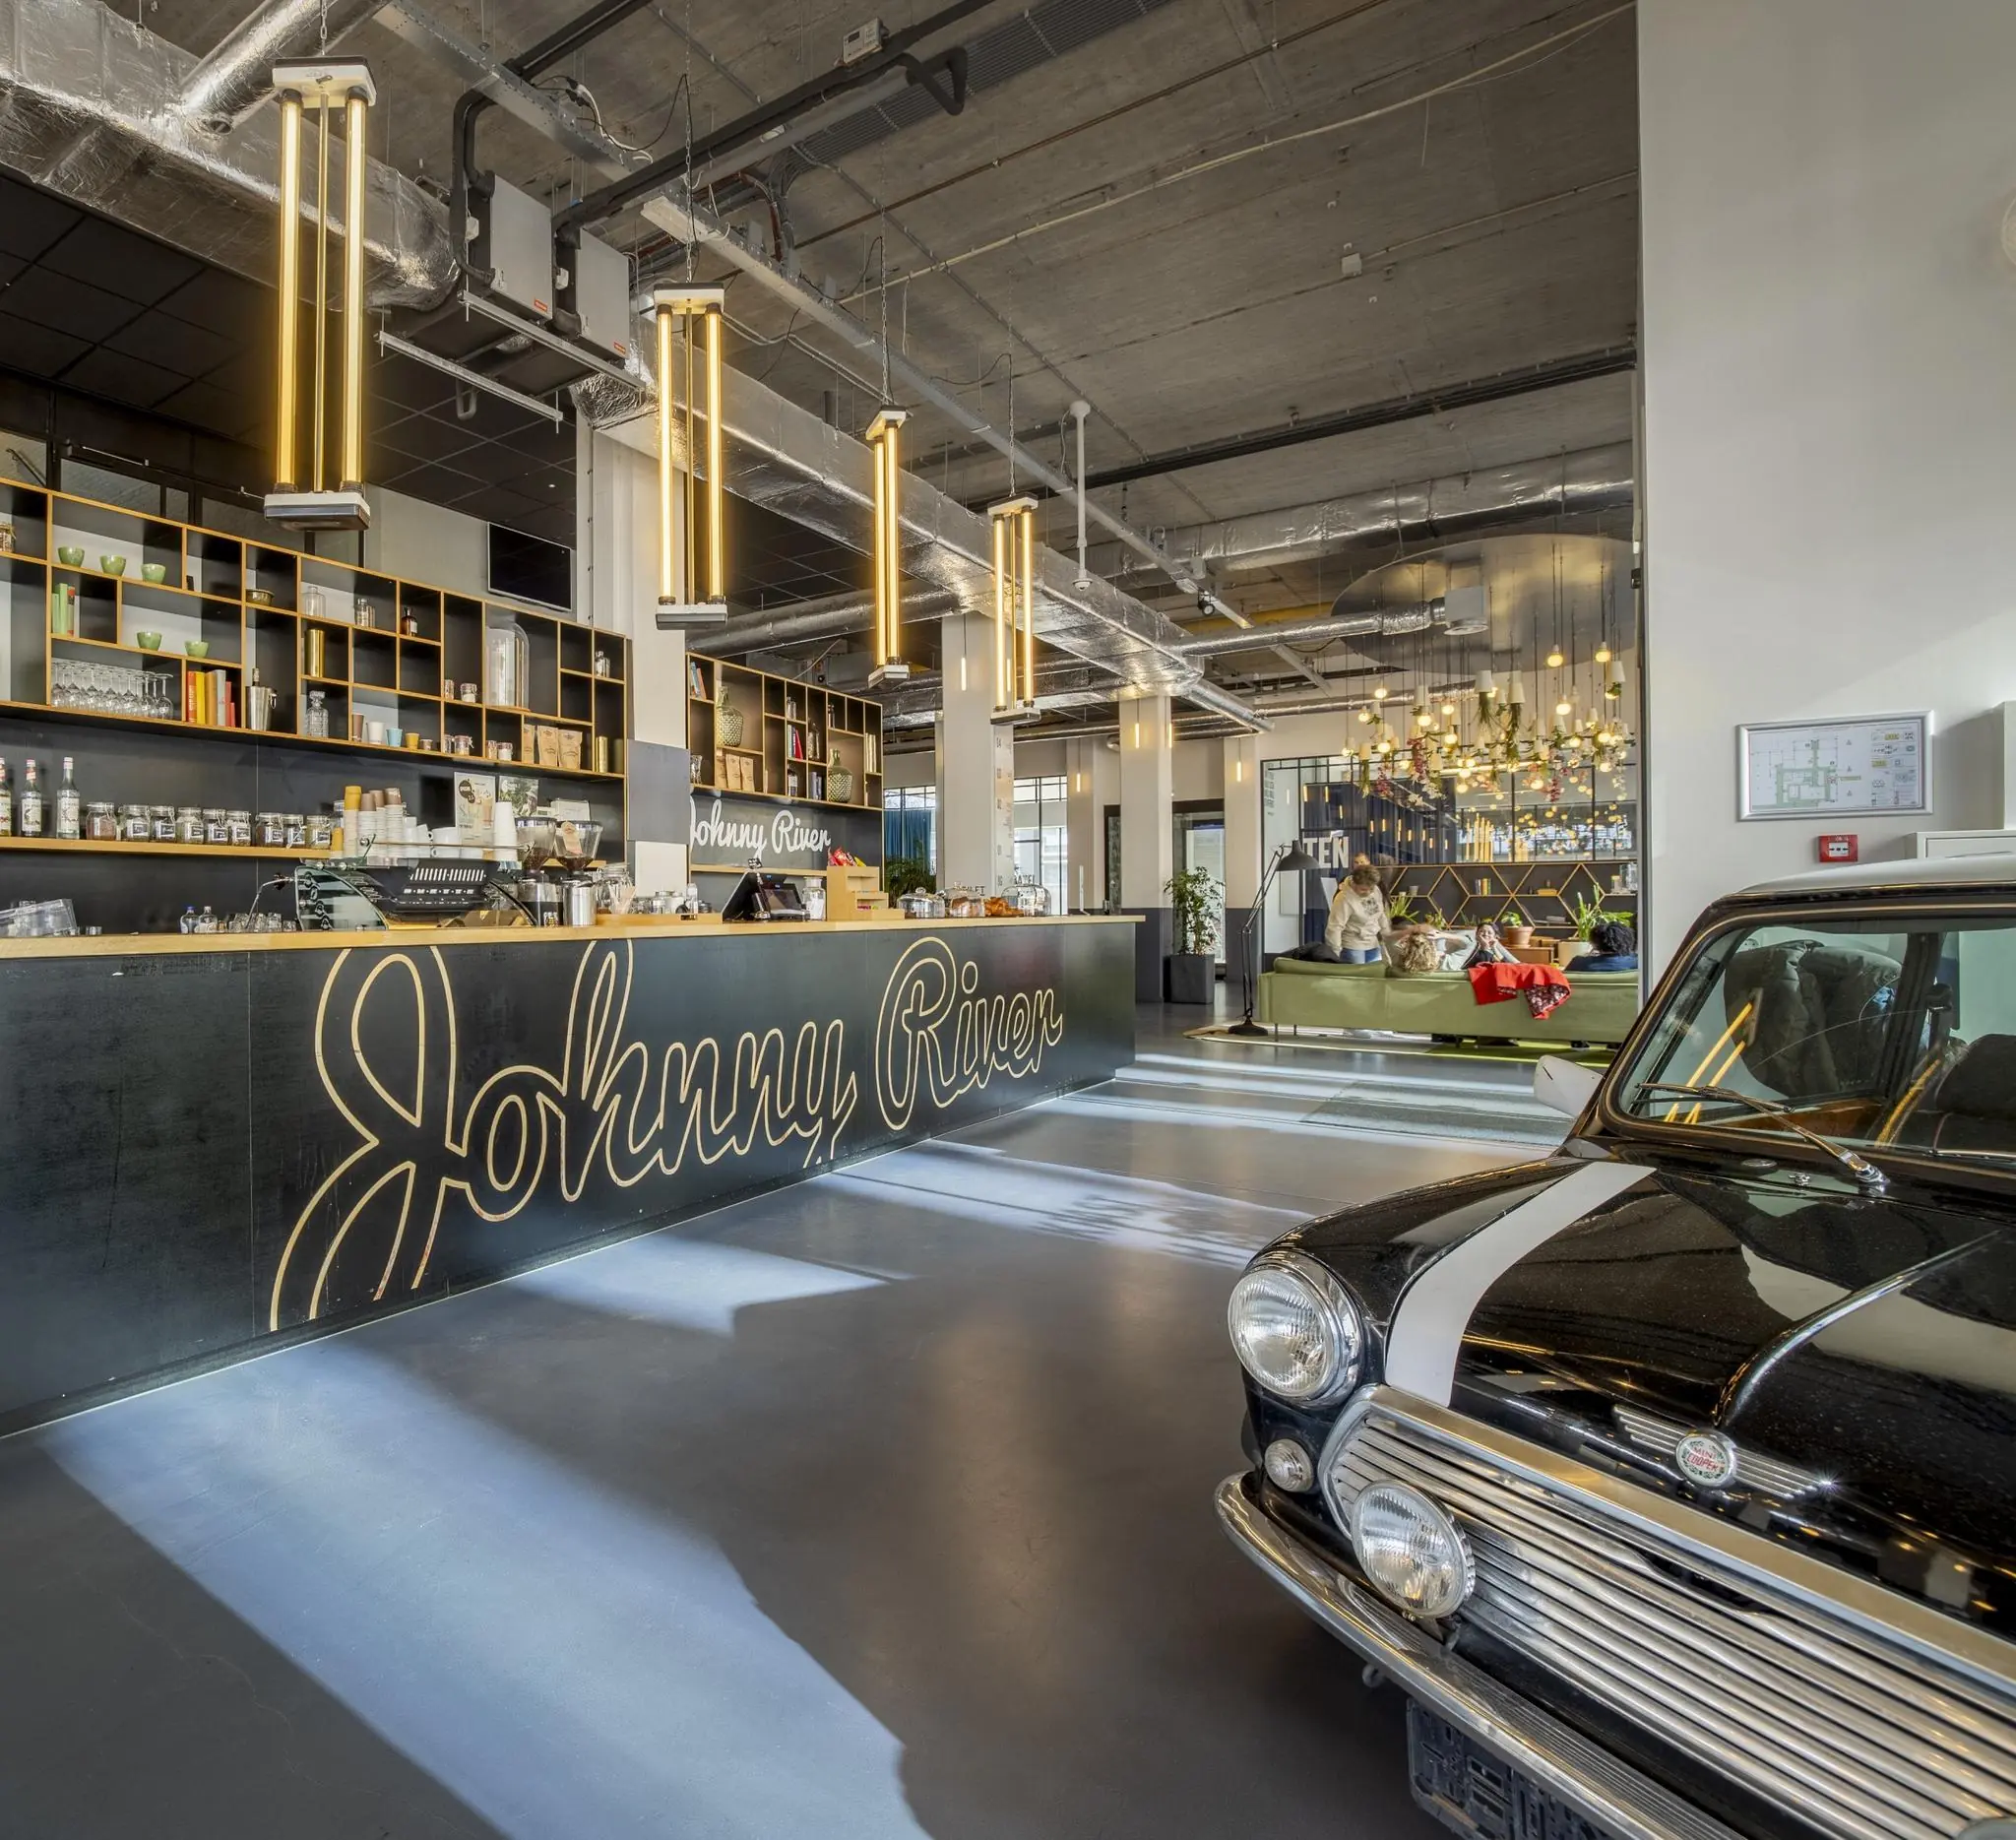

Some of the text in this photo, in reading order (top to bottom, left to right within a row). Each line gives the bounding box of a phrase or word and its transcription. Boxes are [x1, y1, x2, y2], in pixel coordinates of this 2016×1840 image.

[772, 810, 832, 854] River
[270, 936, 1062, 1331] Johnny River
[1692, 1446, 1716, 1458] MINI
